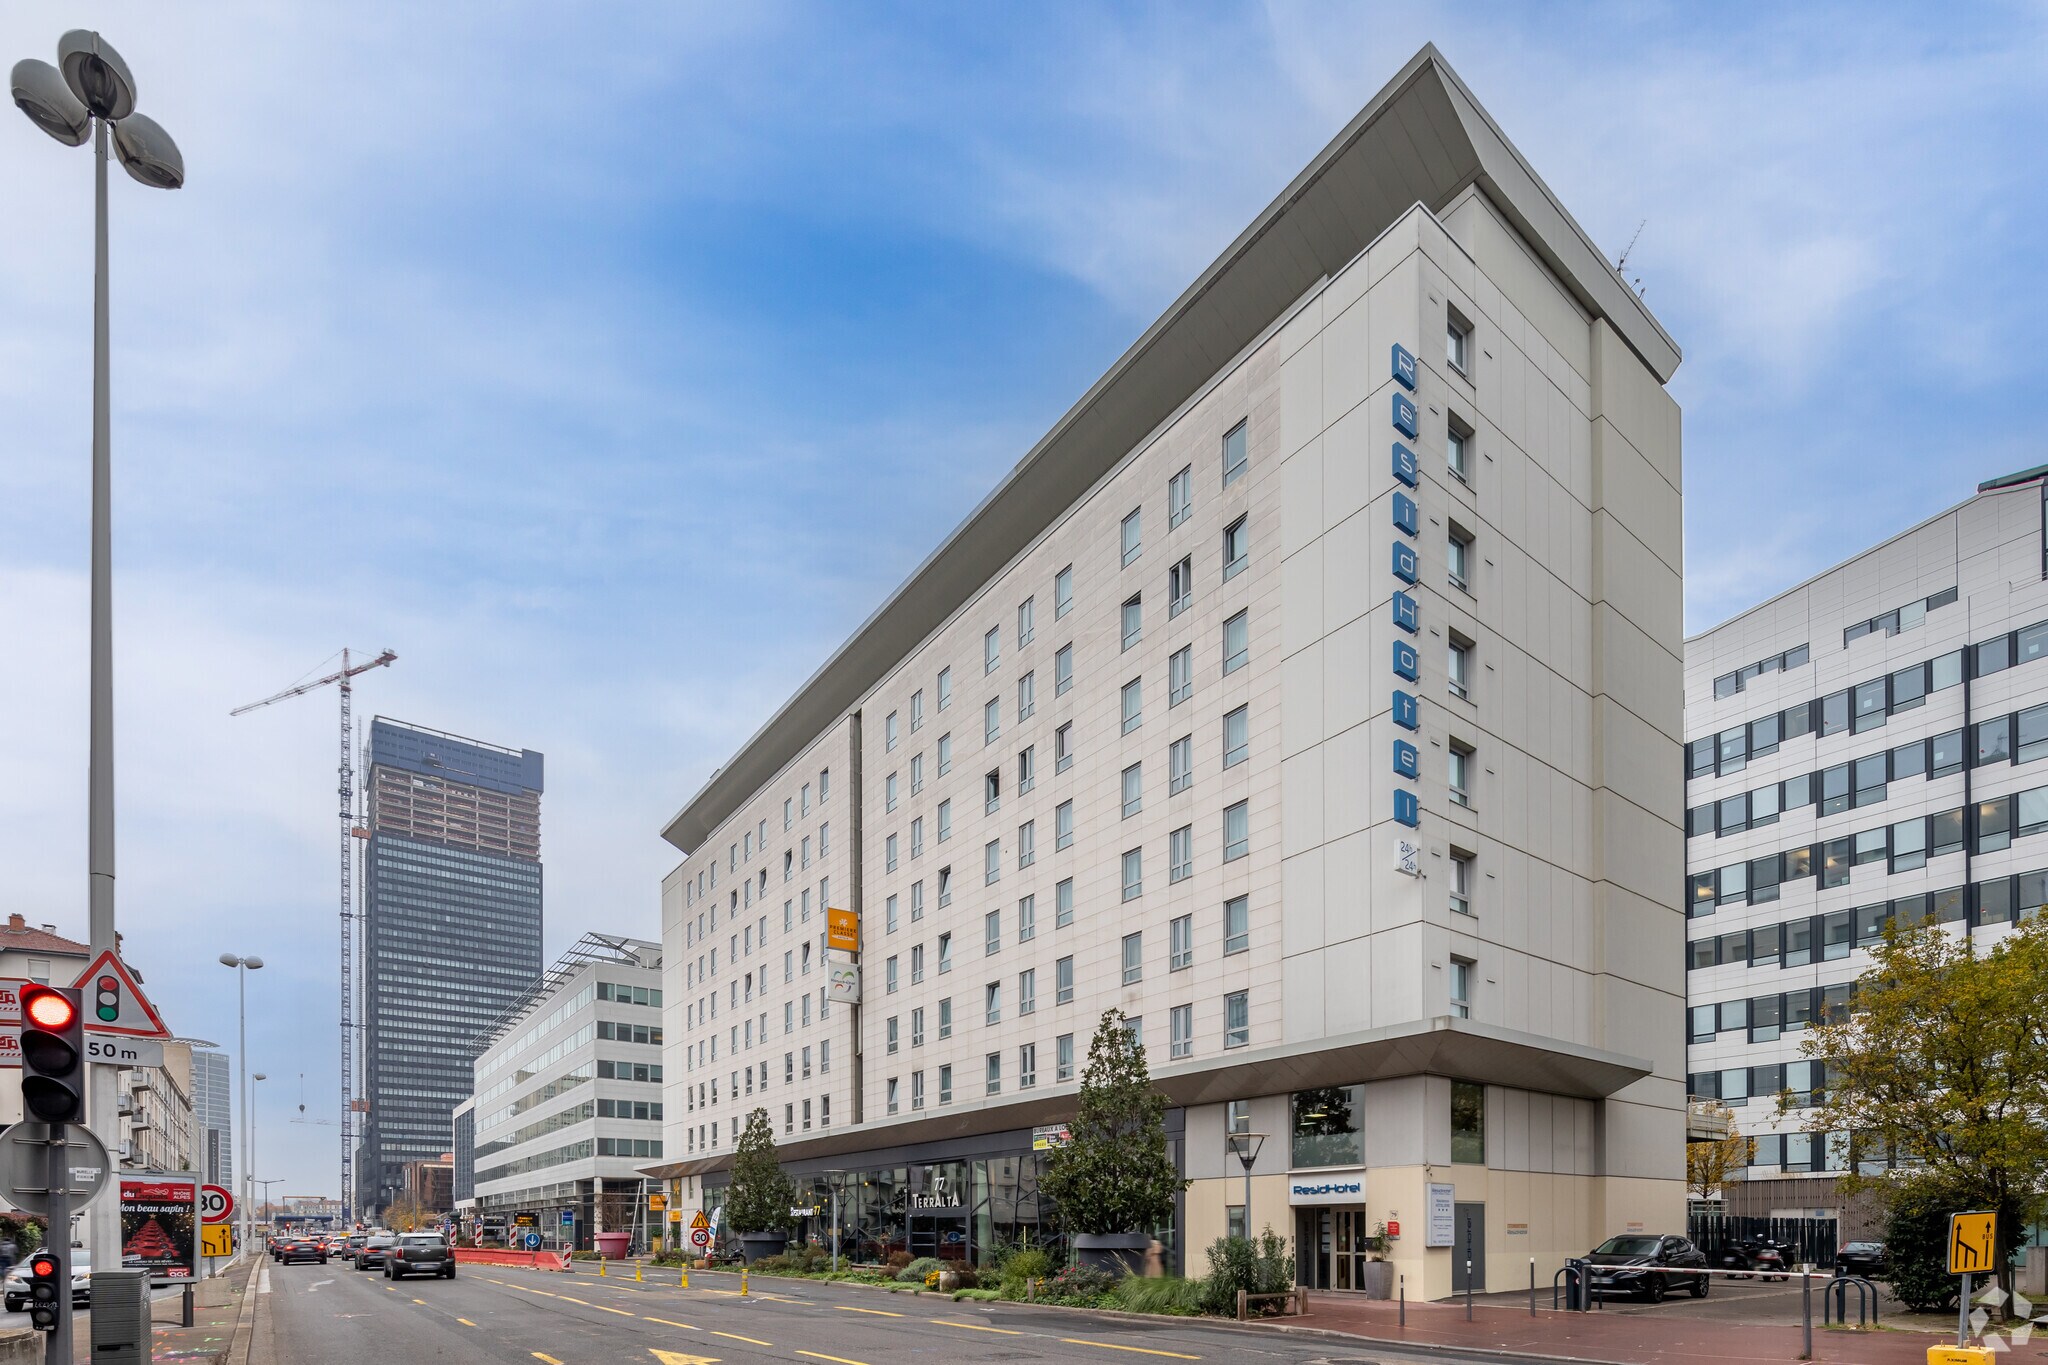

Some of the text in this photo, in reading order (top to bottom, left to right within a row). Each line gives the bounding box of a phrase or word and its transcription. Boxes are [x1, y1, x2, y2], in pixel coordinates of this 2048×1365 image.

[1398, 351, 1415, 818] ResidHotel
[88, 1042, 137, 1060] 50 m
[934, 1177, 945, 1191] 77
[1293, 1182, 1361, 1195] ResidHotel
[137, 1204, 159, 1213] beau
[160, 1205, 184, 1215] sapin
[695, 1233, 707, 1242] 30
